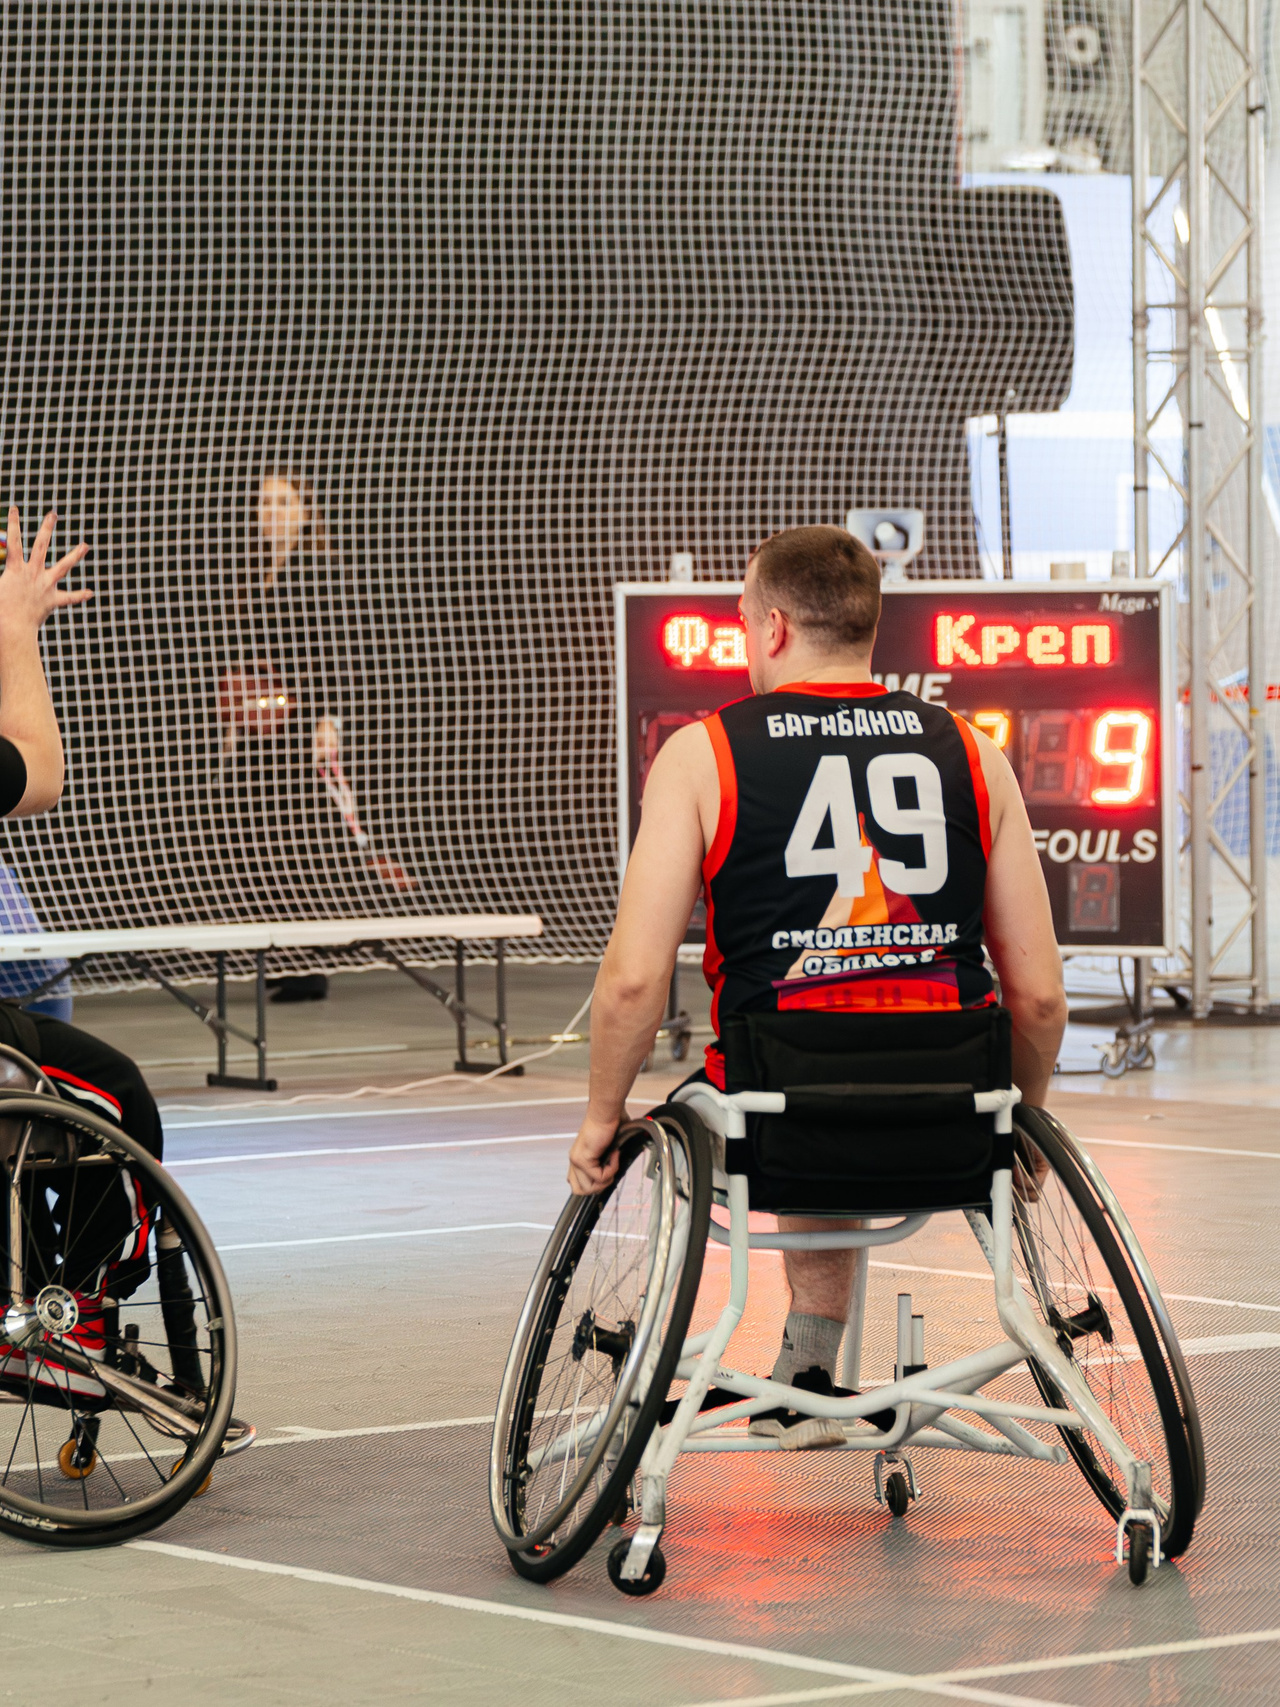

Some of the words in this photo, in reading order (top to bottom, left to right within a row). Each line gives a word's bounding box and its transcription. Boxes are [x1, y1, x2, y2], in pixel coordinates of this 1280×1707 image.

[664, 616, 748, 667] Фа
[936, 614, 1111, 666] Креп
[873, 673, 952, 707] ME
[1091, 710, 1152, 804] 9
[784, 752, 949, 899] 49
[1033, 828, 1159, 863] FOULS
[772, 922, 960, 950] СМОЛЕНСКАЯ
